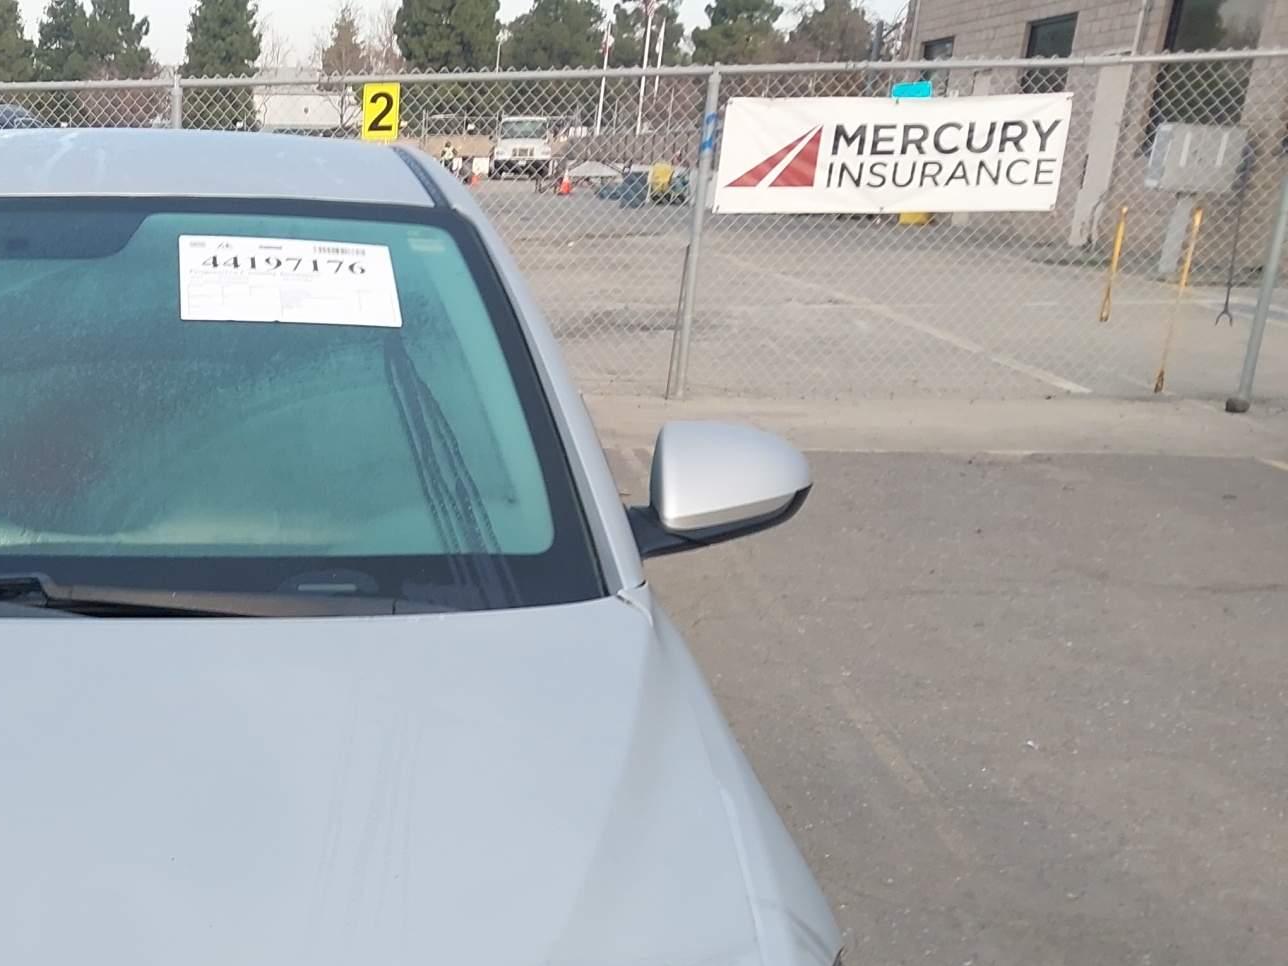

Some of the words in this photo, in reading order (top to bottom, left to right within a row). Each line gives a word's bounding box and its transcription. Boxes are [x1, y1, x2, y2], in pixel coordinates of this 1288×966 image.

[368, 92, 394, 132] 2
[831, 119, 1062, 156] MERCURY
[826, 158, 1057, 188] INSURANCE
[201, 254, 367, 275] 44197176
